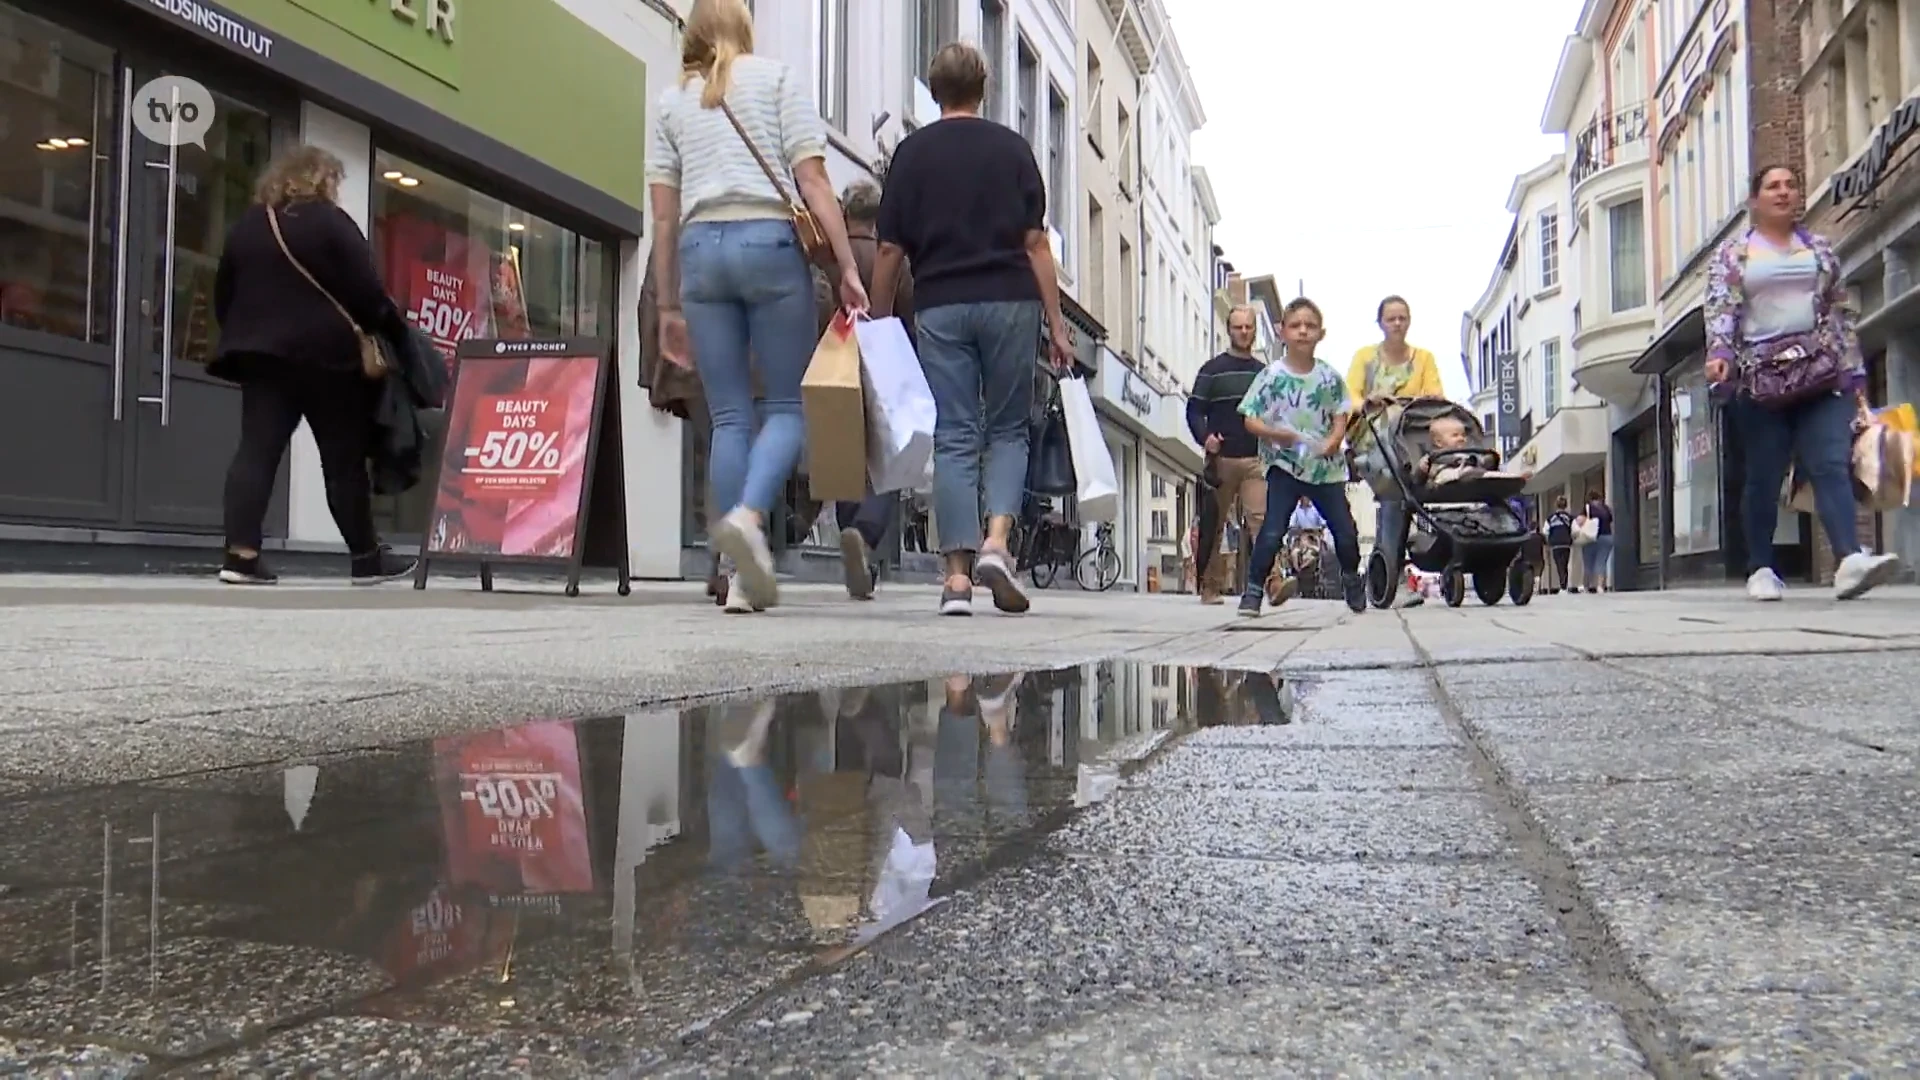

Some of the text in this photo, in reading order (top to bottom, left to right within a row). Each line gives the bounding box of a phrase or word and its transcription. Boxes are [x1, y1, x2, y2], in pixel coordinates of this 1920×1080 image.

[426, 268, 464, 292] BEAUTY
[432, 285, 458, 303] DAYS
[406, 297, 474, 341] -50%
[530, 343, 567, 352] ROCHER
[1502, 360, 1515, 414] OPTIEK
[495, 399, 549, 413] BEAUTY
[502, 414, 537, 429] DAYS
[463, 430, 560, 469] -50%
